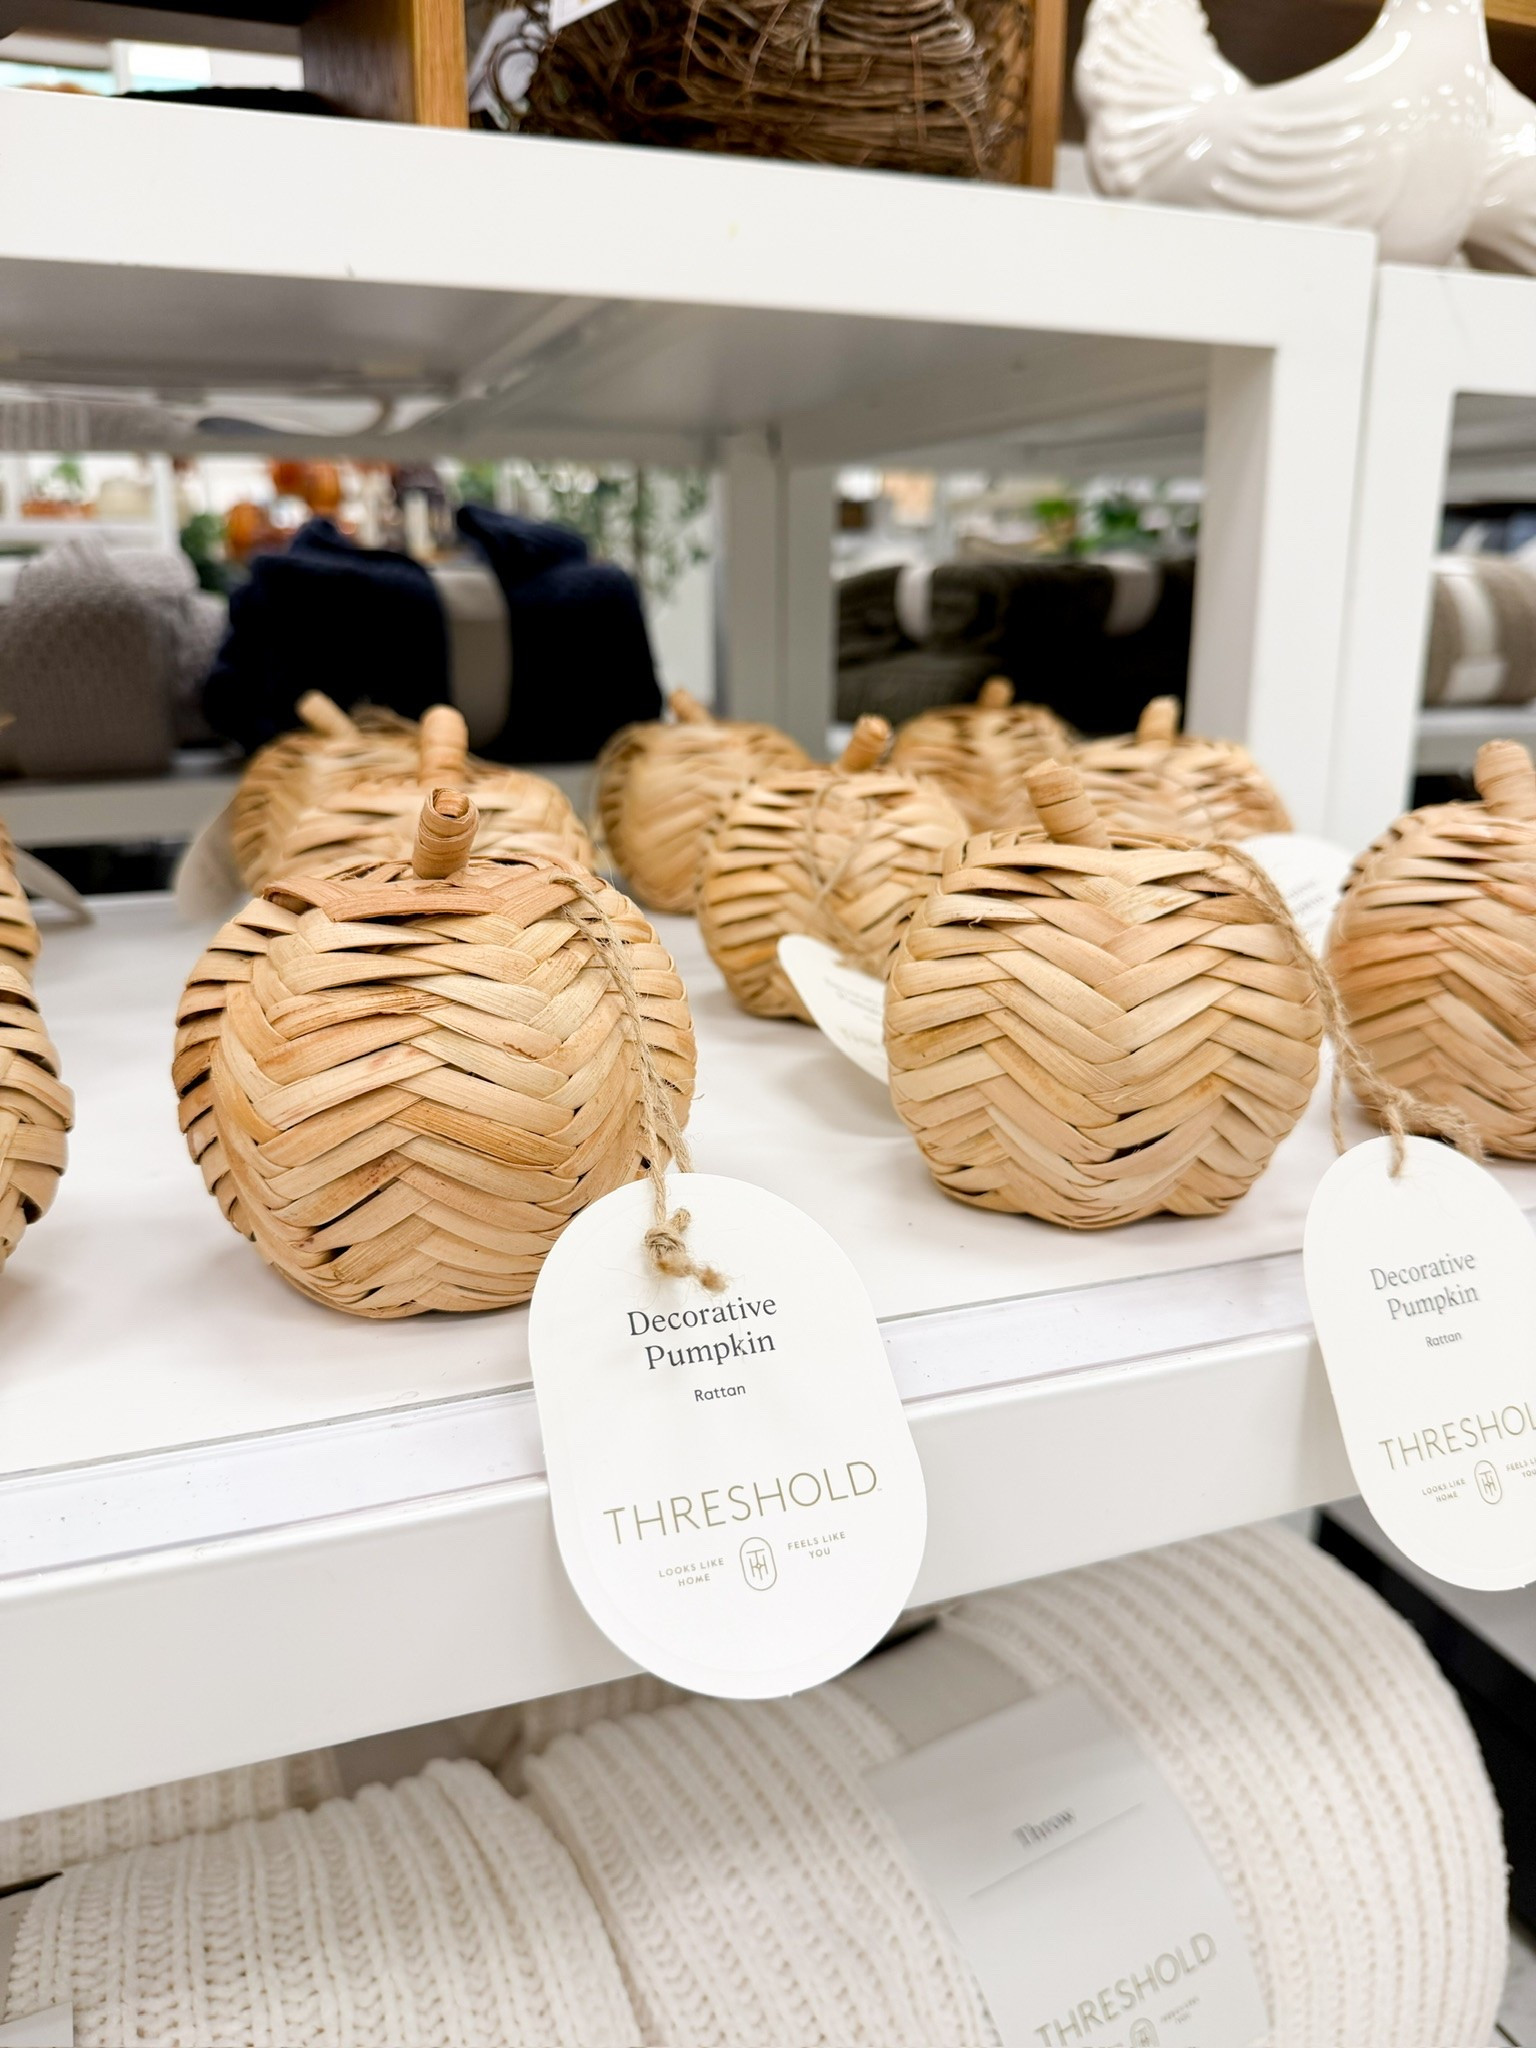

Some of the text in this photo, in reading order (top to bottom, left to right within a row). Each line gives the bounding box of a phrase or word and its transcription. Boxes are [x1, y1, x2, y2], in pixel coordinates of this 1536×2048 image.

[1370, 1252, 1477, 1291] Decorative
[627, 1296, 778, 1336] Decorative
[1386, 1284, 1480, 1320] Pumpkin
[645, 1331, 777, 1370] Pumpkin
[1425, 1331, 1463, 1348] Rattan
[694, 1383, 747, 1402] Rattan
[603, 1461, 879, 1545] THRESHOLD
[787, 1531, 846, 1551] FEELS LIKE
[808, 1547, 832, 1560] YOU
[658, 1557, 725, 1578] LOOKS LIKE
[677, 1573, 712, 1587] HOME
[1034, 1932, 1217, 2048] THRESHOLD
